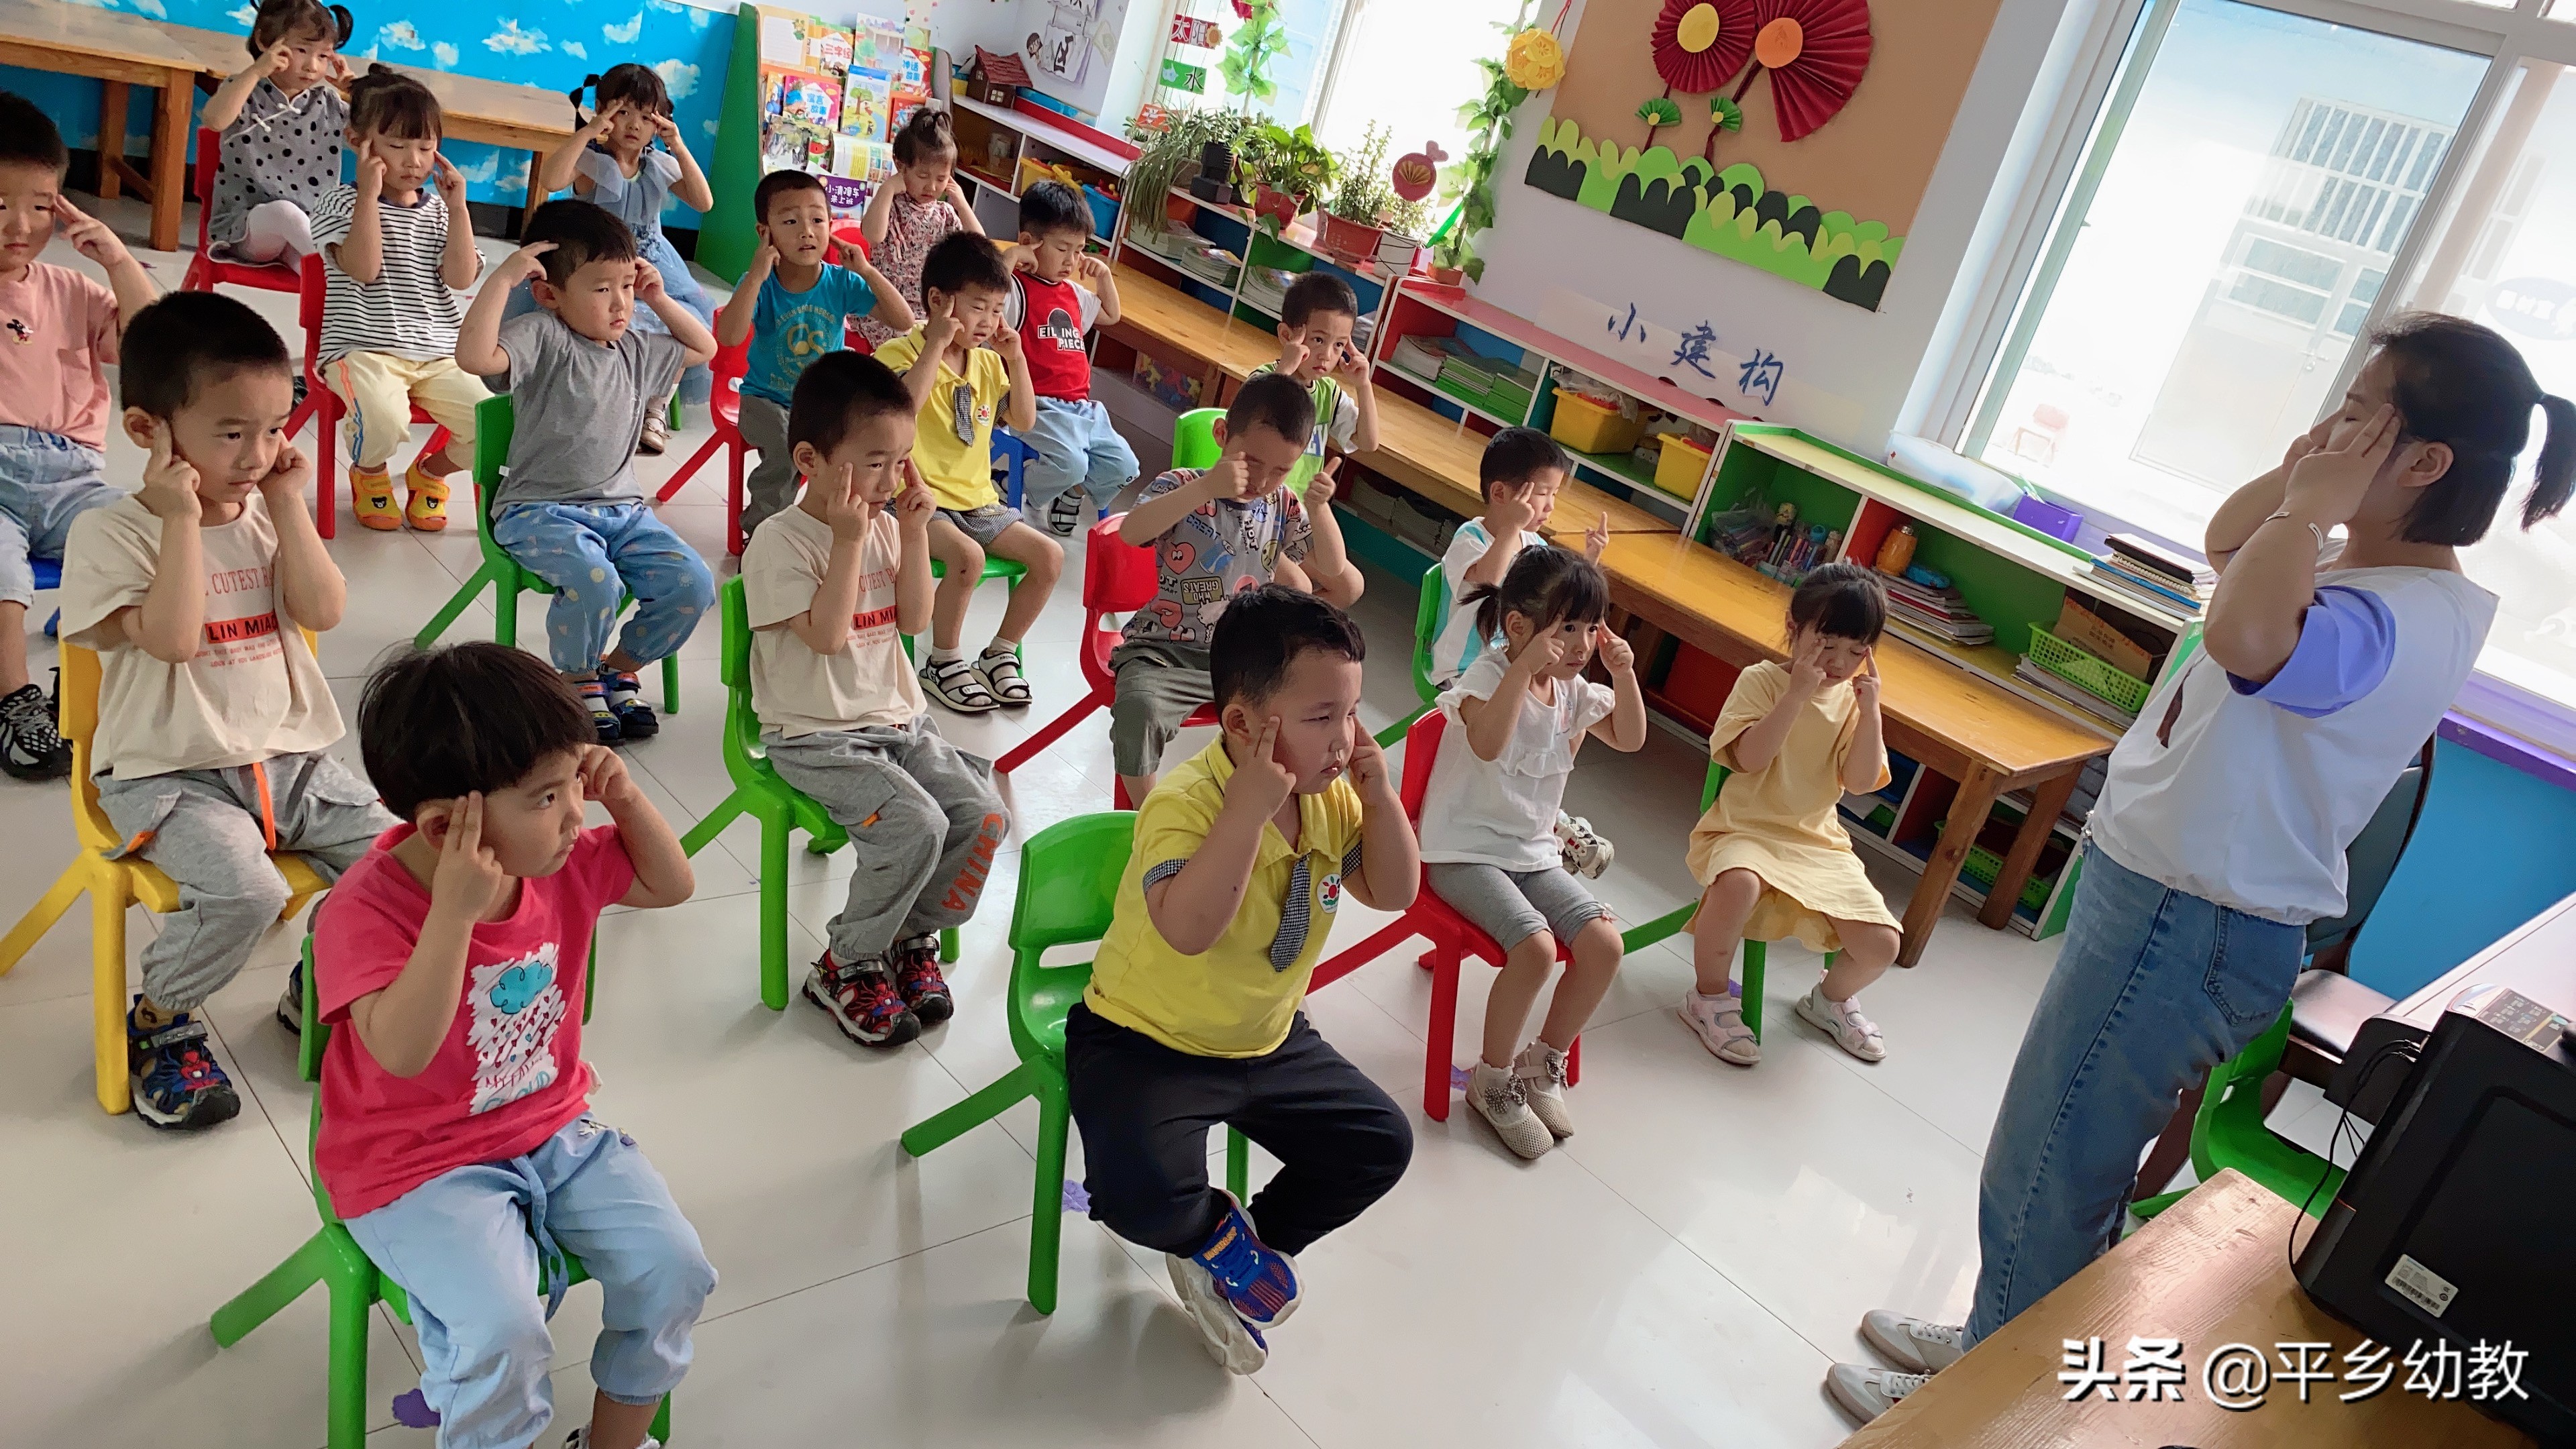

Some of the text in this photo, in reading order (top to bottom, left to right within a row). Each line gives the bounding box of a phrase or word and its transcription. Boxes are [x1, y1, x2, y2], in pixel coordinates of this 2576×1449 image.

[1171, 17, 1207, 46] 太阳
[1183, 67, 1204, 91] 水
[1608, 303, 1784, 406] 小建构
[212, 568, 260, 595] CUTEST
[1159, 574, 1178, 586] OT
[1183, 580, 1219, 593] GREATS
[208, 623, 237, 641] LIN
[855, 614, 875, 629] LIN
